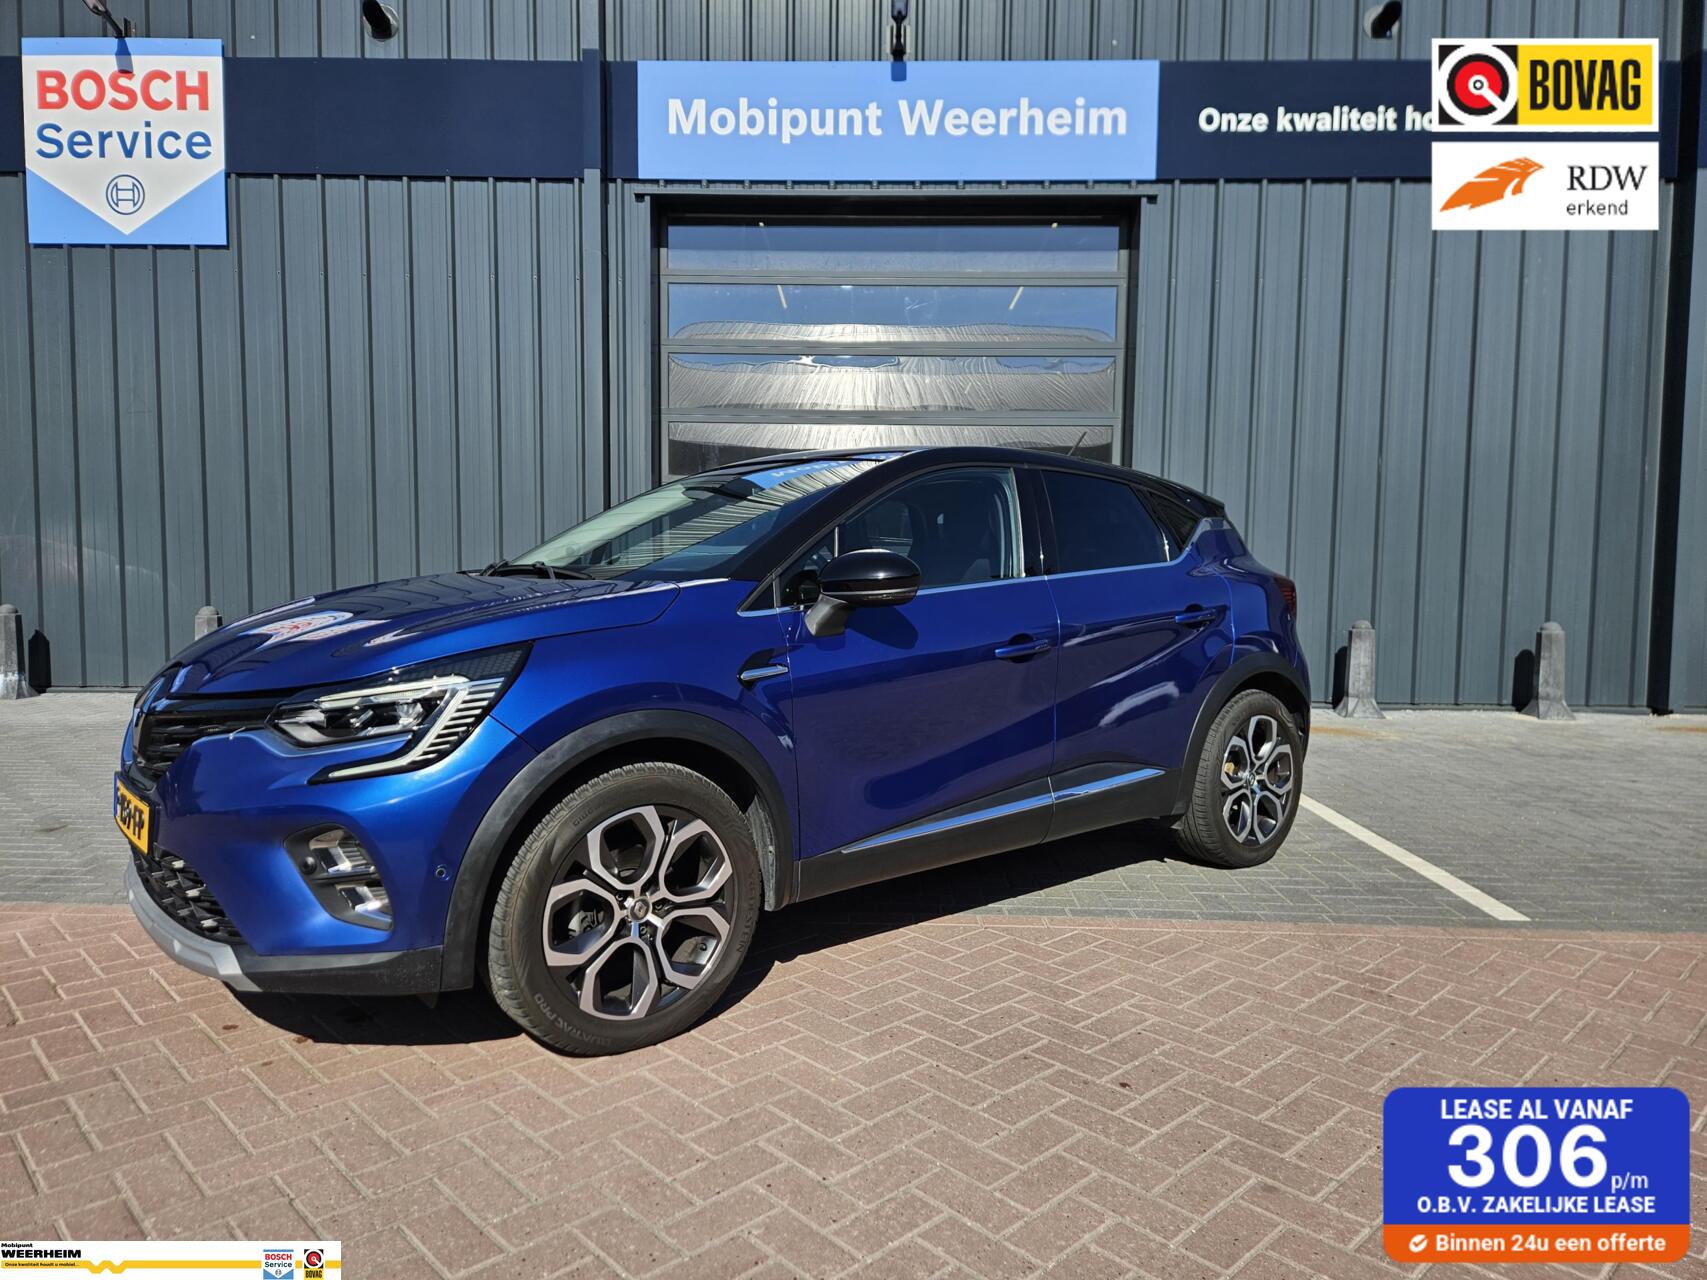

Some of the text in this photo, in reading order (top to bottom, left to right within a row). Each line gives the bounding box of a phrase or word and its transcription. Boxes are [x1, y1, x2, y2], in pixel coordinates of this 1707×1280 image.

[37, 69, 209, 111] BOSCH
[668, 97, 1127, 144] Mobipunt Weerheim
[1198, 107, 1269, 133] Onze
[1276, 105, 1398, 132] kwaliteit
[36, 120, 212, 160] Service
